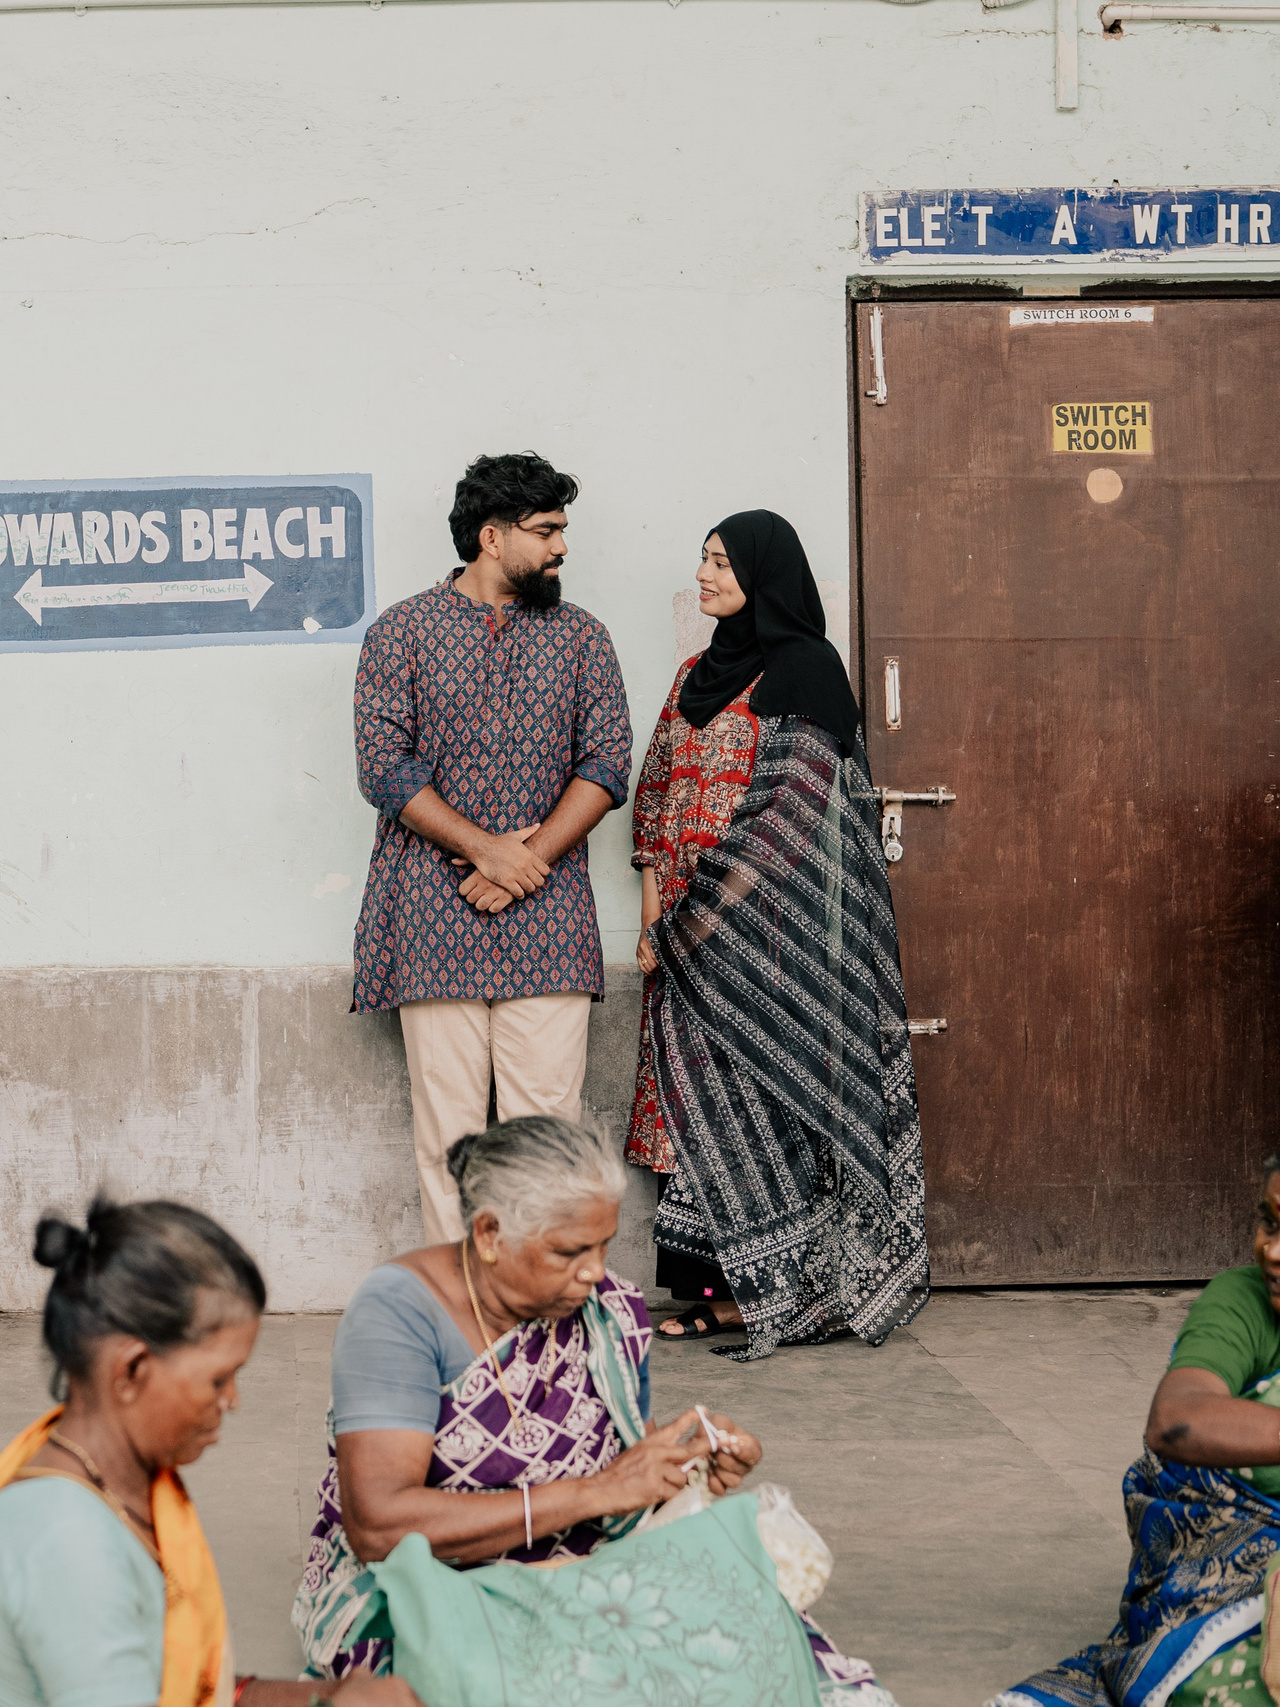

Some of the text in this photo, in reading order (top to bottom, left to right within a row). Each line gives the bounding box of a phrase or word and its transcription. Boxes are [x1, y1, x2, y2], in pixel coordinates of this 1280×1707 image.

[1023, 308, 1132, 320] SWITCH ROOM 6
[1055, 405, 1147, 427] SWITCH
[1067, 429, 1137, 451] ROOM
[181, 506, 346, 562] BEACH
